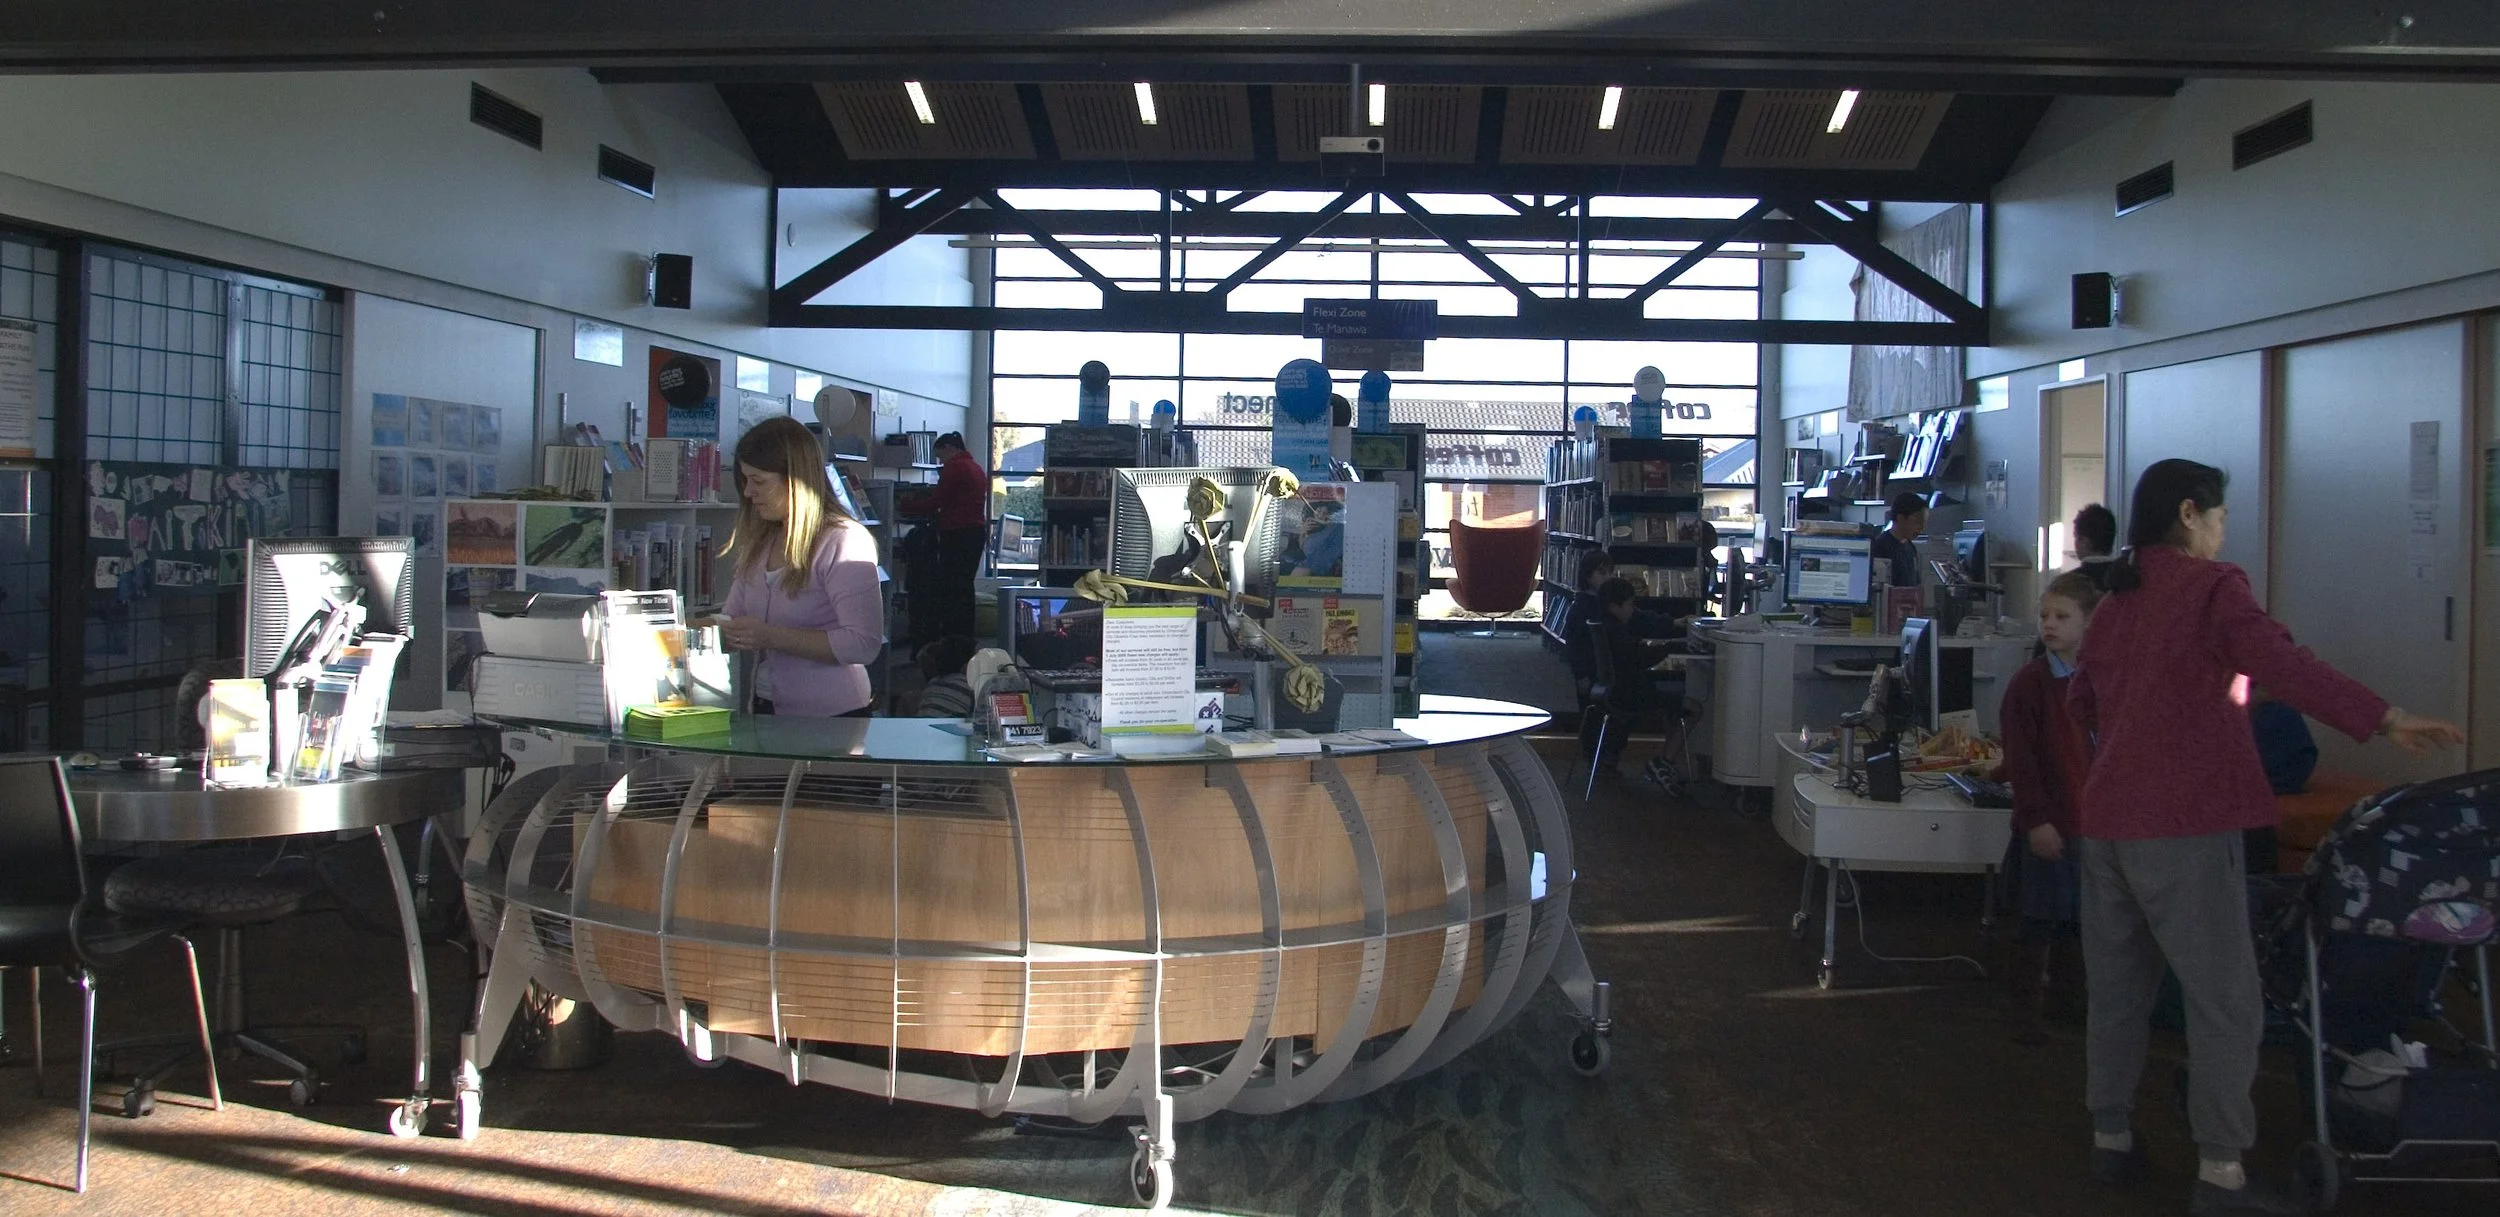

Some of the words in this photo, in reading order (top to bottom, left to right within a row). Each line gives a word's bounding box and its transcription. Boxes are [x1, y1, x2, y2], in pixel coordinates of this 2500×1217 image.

[1313, 306, 1337, 318] Flexi
[1339, 306, 1367, 318] Zone
[1313, 323, 1325, 334] Te
[1327, 323, 1368, 335] Manawa
[319, 560, 368, 576] DELL
